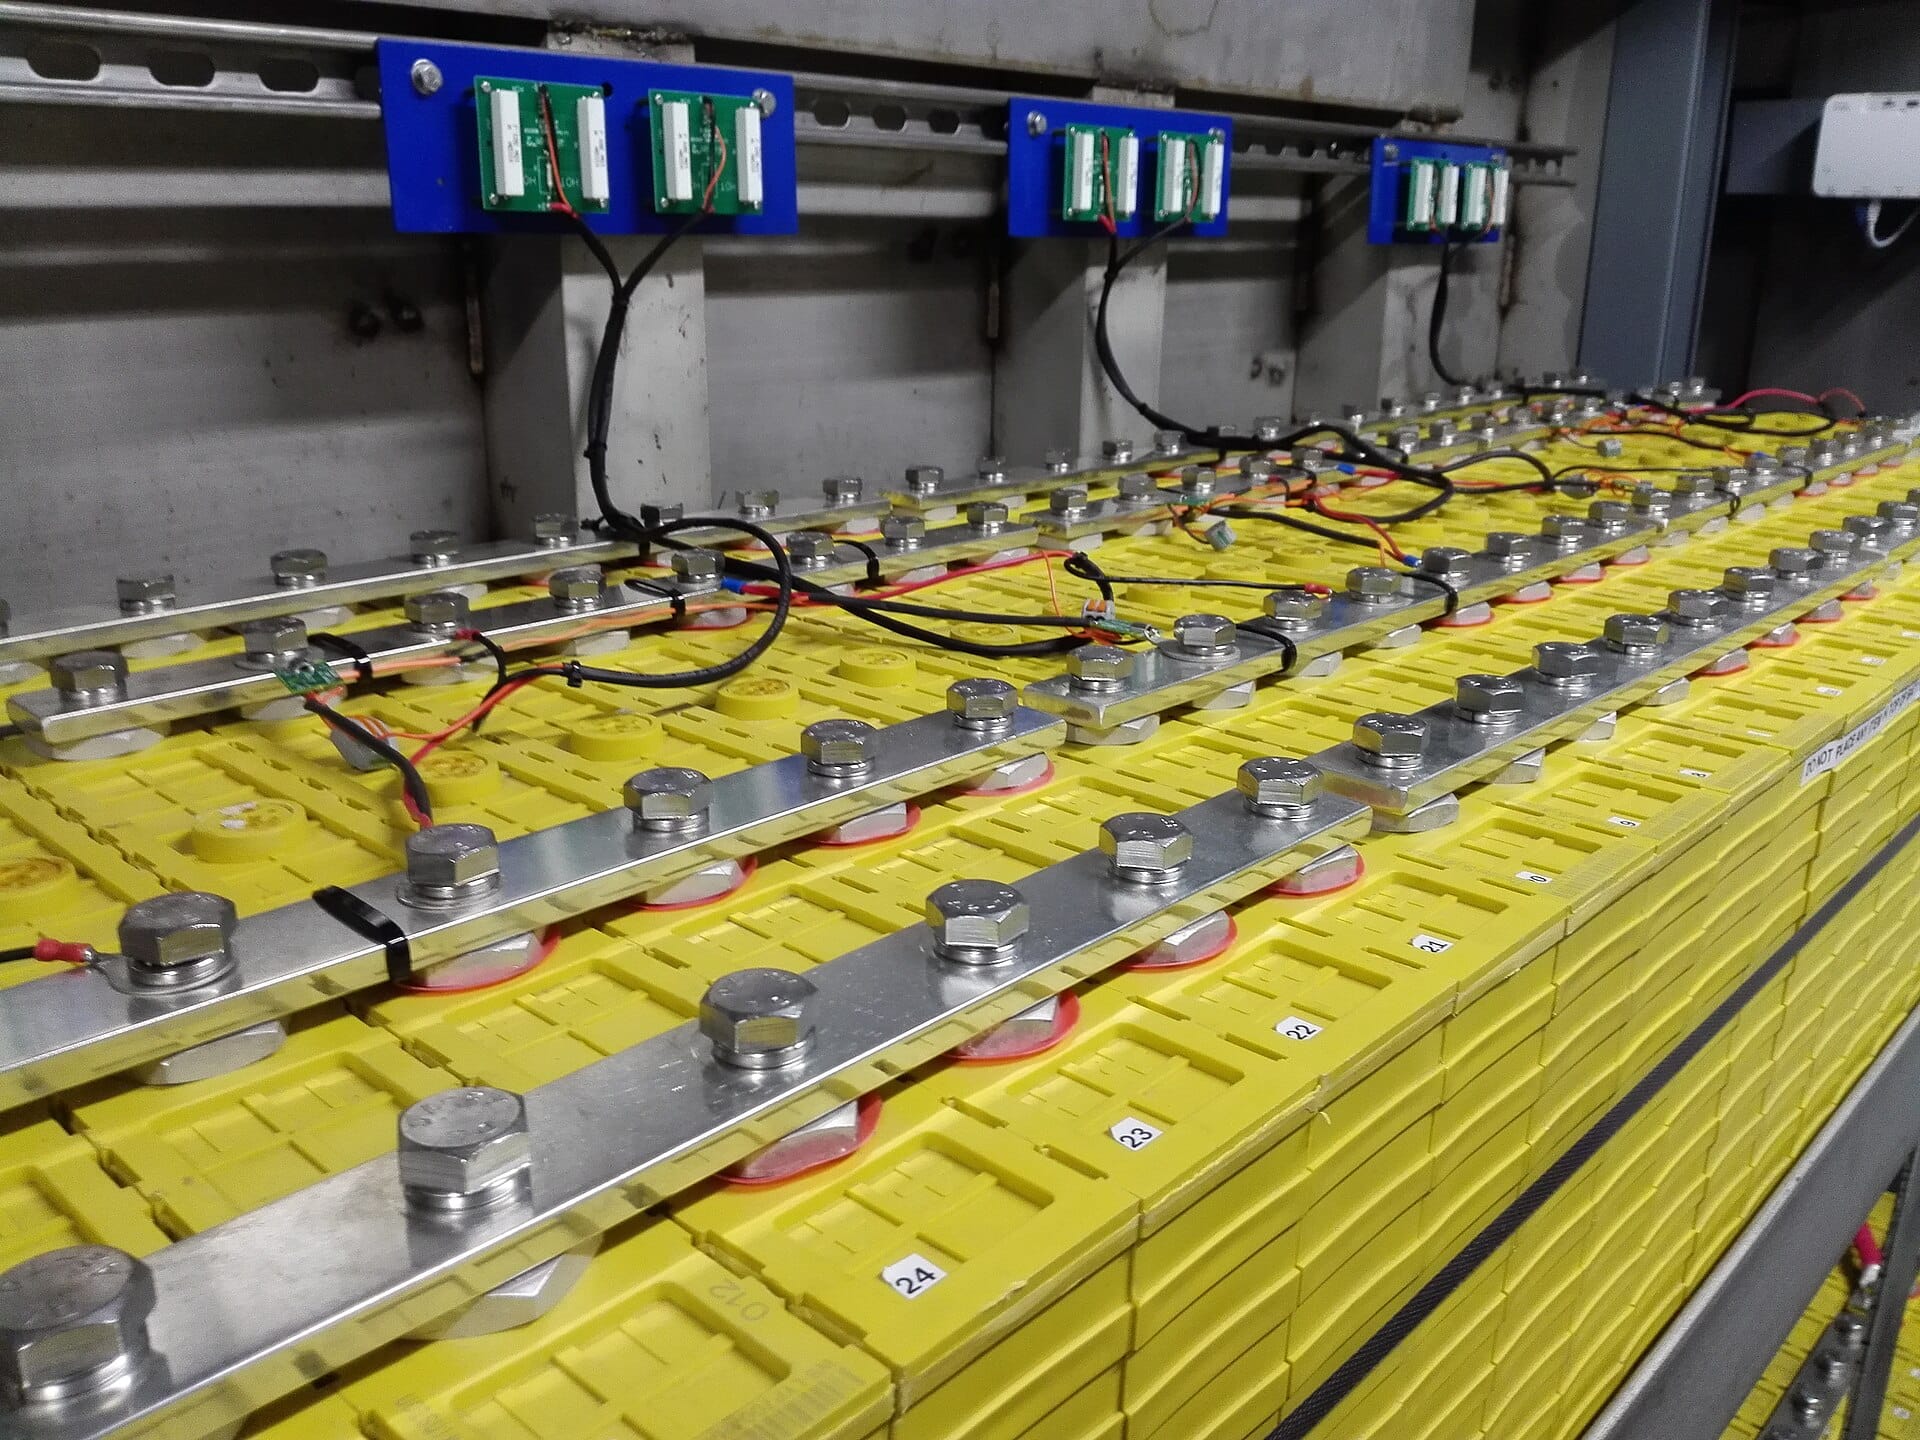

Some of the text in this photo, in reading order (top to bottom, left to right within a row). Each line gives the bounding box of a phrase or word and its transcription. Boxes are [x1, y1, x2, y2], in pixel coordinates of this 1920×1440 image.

[1816, 748, 1834, 767] NOT
[1420, 940, 1448, 953] 21
[1286, 1024, 1316, 1040] 22
[1120, 1127, 1153, 1148] 23
[895, 1266, 937, 1294] 24
